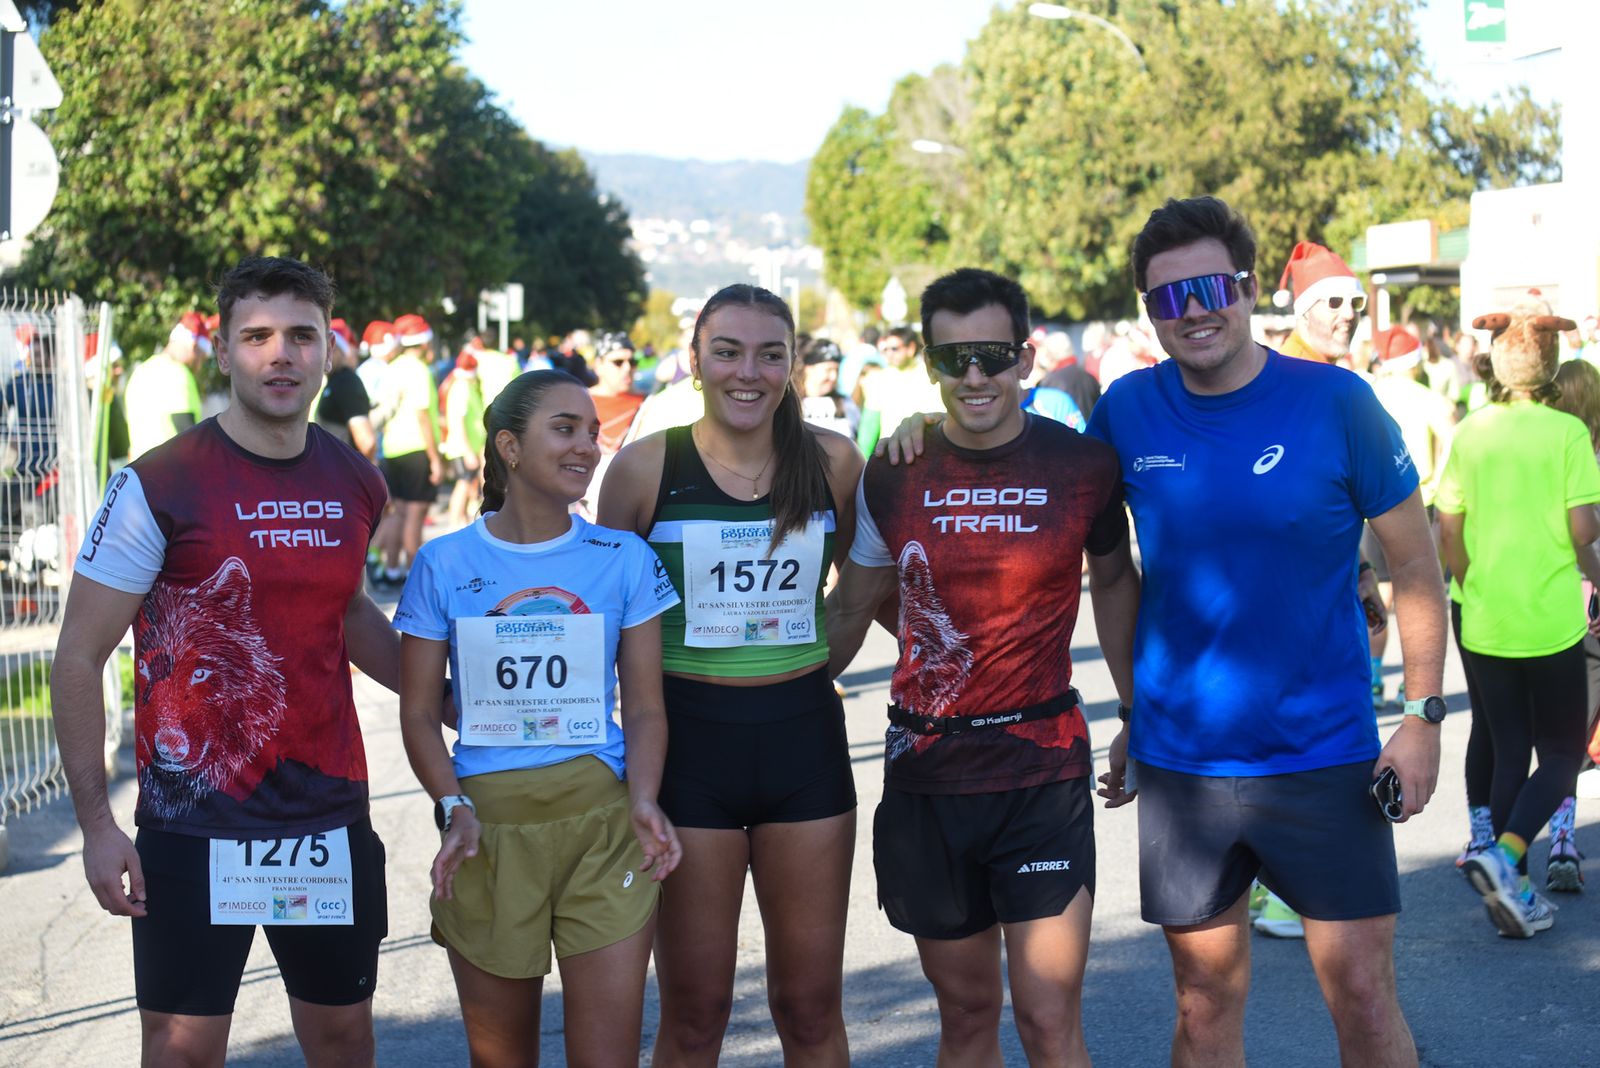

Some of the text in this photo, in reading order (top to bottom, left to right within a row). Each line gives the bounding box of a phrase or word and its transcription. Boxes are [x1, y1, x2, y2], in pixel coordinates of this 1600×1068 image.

[924, 488, 1048, 507] LOBOS
[235, 501, 343, 521] LOBOS
[82, 471, 128, 563] LOBOS
[932, 515, 1038, 533] TRAIL
[250, 529, 341, 549] TRAIL
[710, 559, 800, 593] 1572
[709, 601, 726, 609] SAN
[726, 600, 770, 609] SILVESTRE
[703, 626, 739, 634] IMDECO
[791, 622, 806, 631] GCC
[496, 655, 567, 690] 670
[503, 698, 549, 706] SILVESTRE
[986, 712, 1022, 725] Kalenji
[480, 723, 517, 732] IMDECO
[573, 721, 593, 729] GCC
[1030, 860, 1070, 873] TERREX
[235, 876, 252, 884] SAN
[253, 876, 299, 884] SILVESTRE
[300, 876, 348, 884] CORDOBESA
[228, 901, 267, 910] IMDECO
[321, 901, 340, 910] GCC
